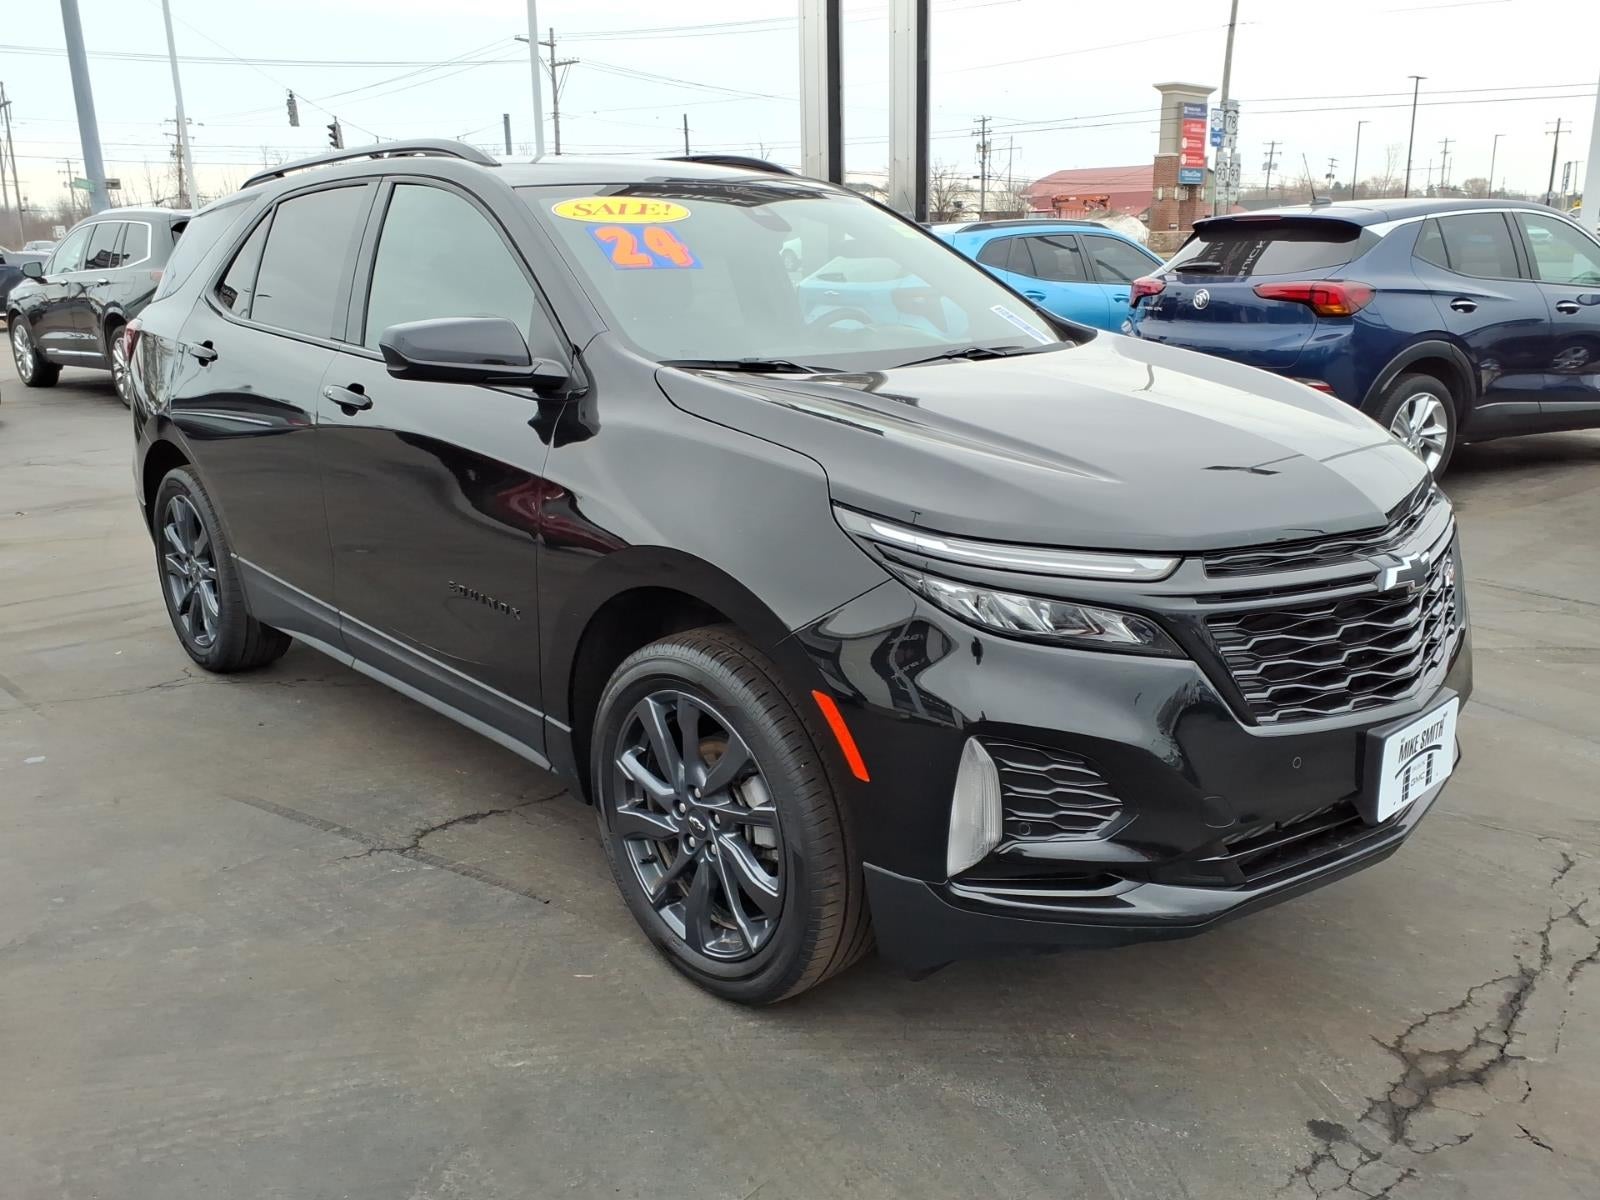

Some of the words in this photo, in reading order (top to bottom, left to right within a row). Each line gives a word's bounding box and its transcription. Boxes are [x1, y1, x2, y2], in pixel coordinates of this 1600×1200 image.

[1227, 115, 1237, 129] 78
[572, 202, 672, 217] SALE!
[594, 226, 694, 268] 24
[1399, 734, 1420, 763] MIKE
[1420, 718, 1445, 749] SMITH
